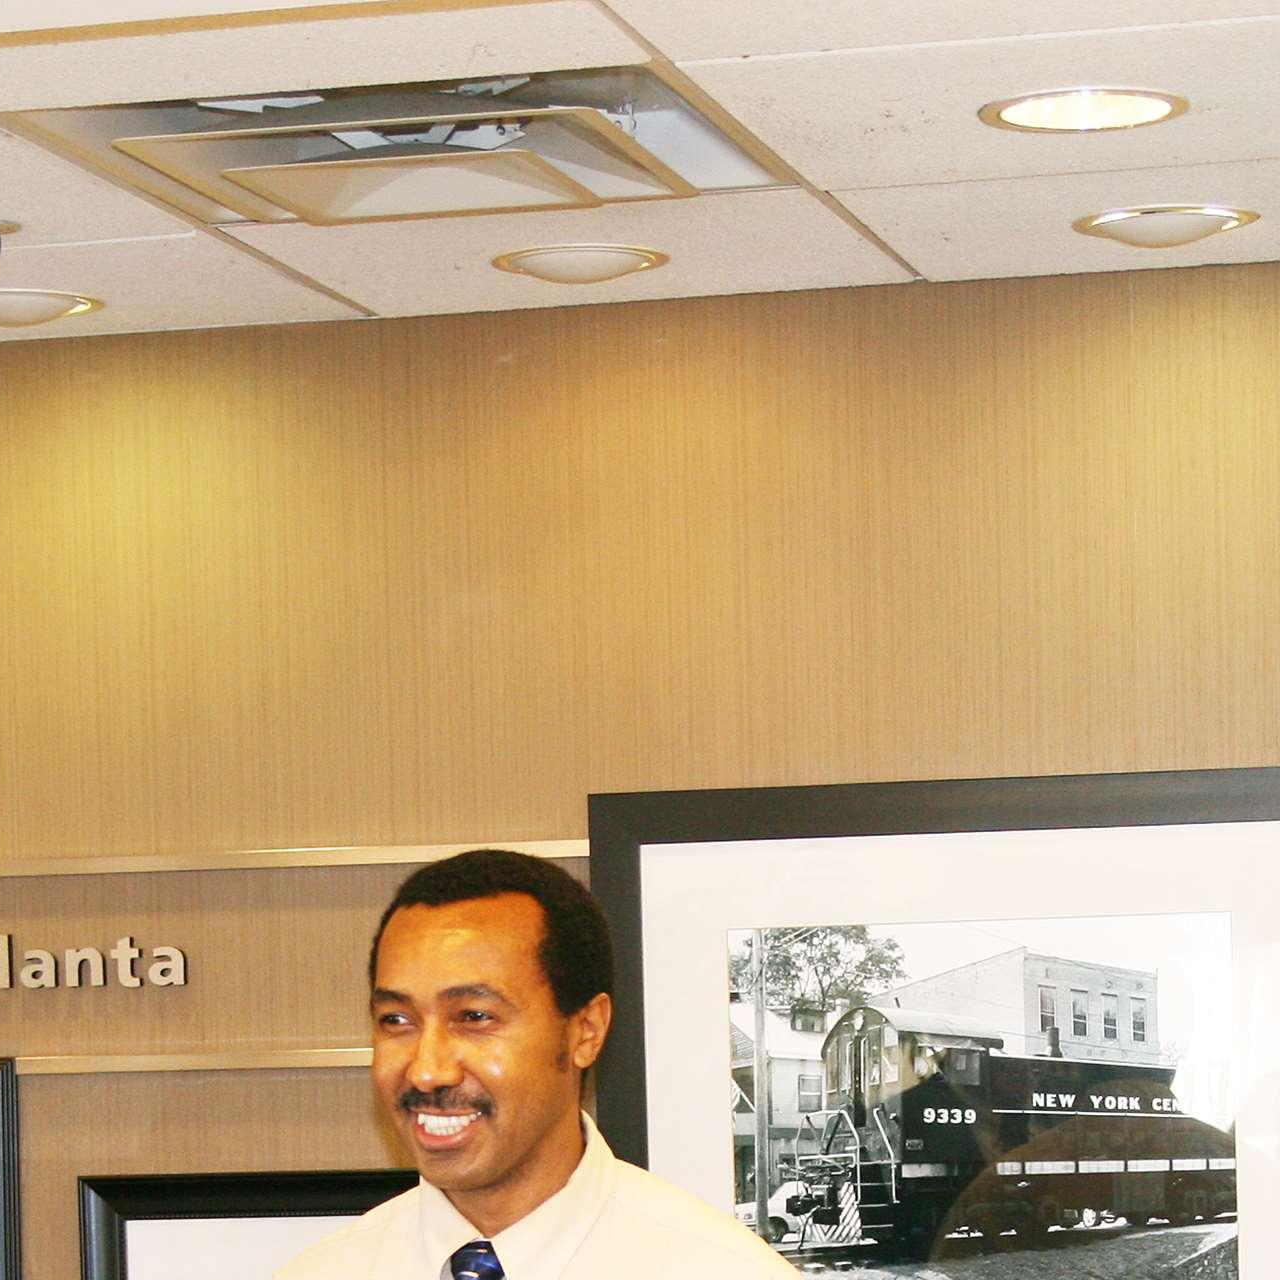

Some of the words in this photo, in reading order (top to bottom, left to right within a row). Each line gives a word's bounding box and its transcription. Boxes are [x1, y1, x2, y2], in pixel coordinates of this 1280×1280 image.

[1031, 1092, 1076, 1109] NEW
[1089, 1095, 1141, 1111] YORK
[922, 1107, 977, 1125] 9339
